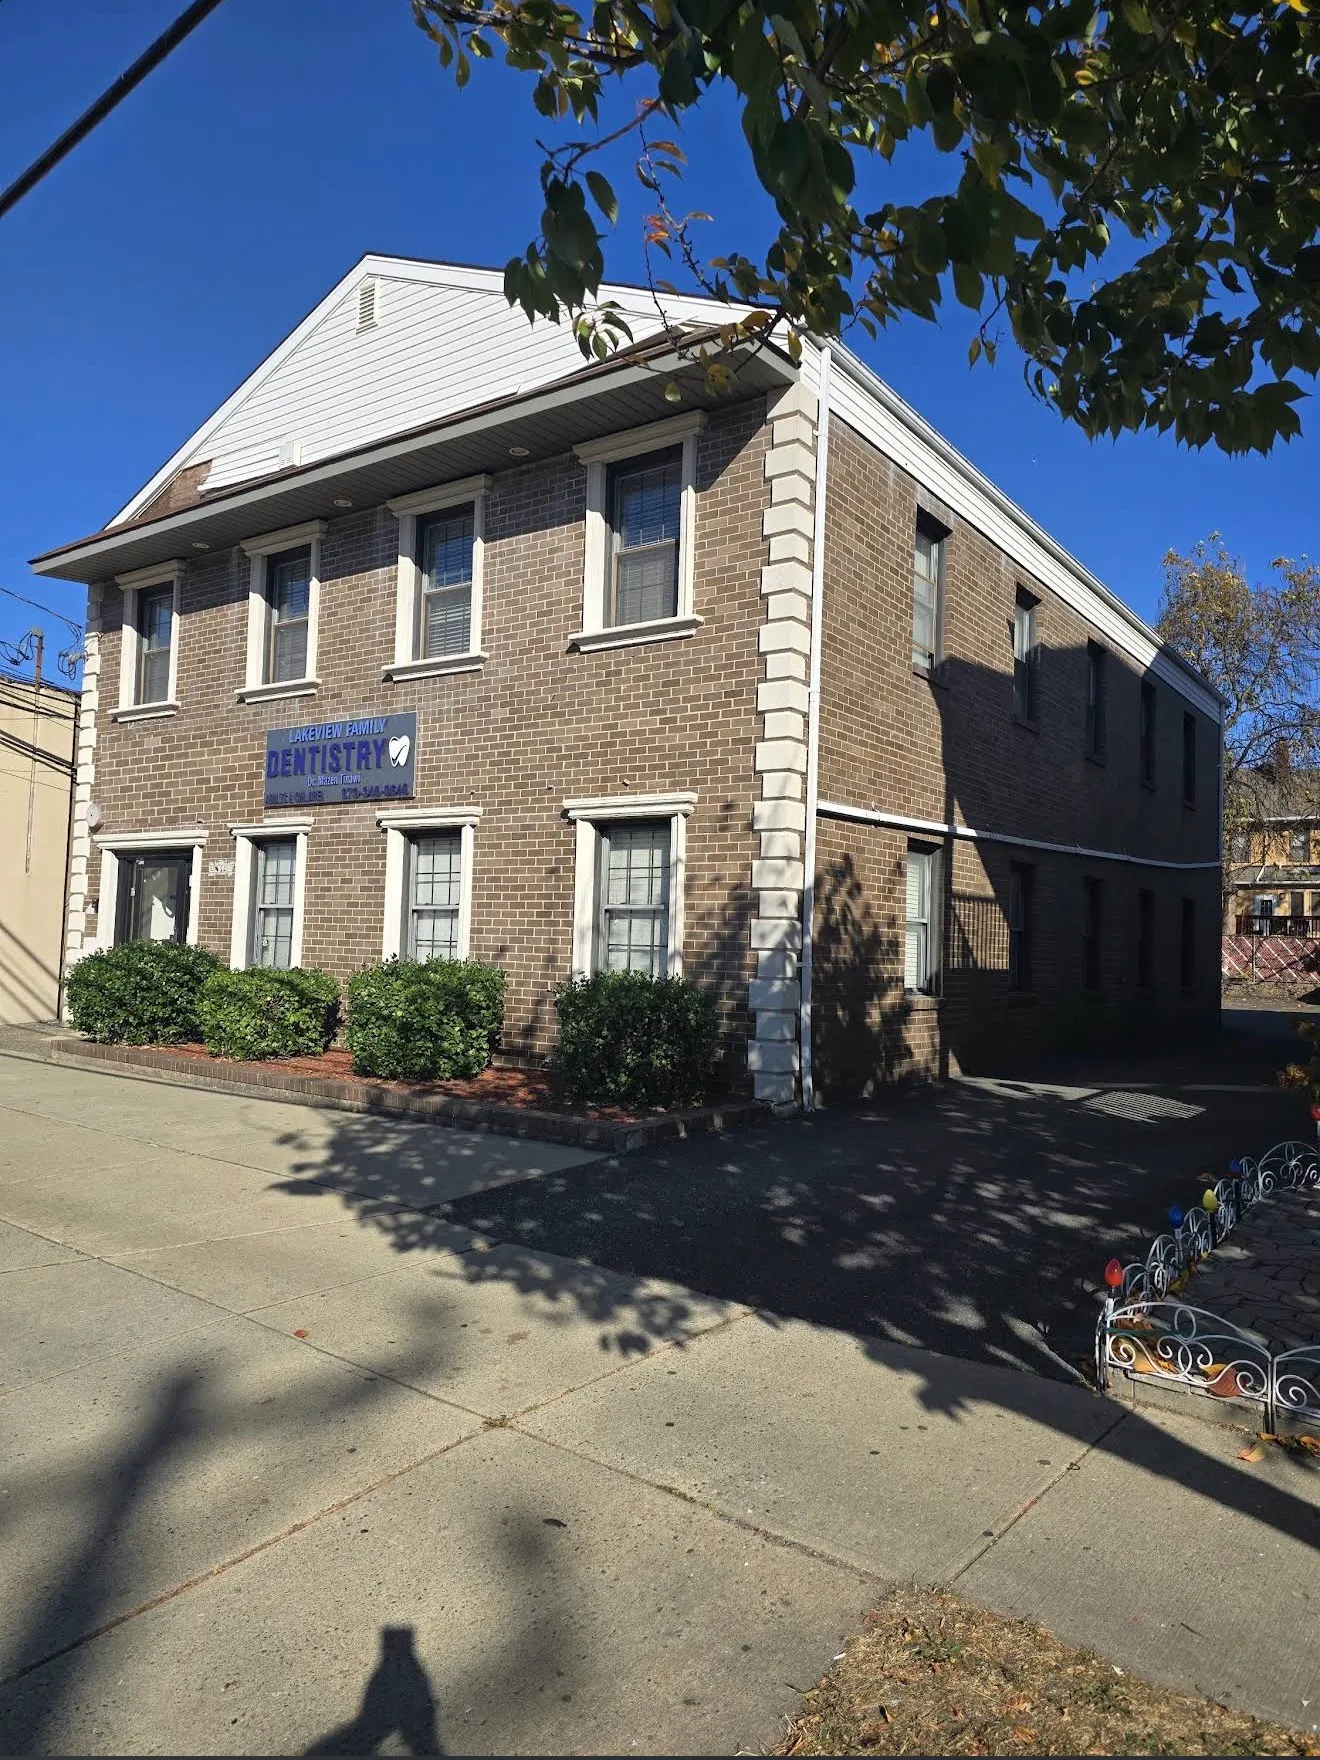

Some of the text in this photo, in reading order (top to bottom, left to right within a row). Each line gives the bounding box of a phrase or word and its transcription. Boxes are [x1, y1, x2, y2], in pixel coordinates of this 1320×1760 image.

[289, 718, 388, 743] LAKEVIEW FAMILY
[267, 738, 388, 778] DENTISTRY
